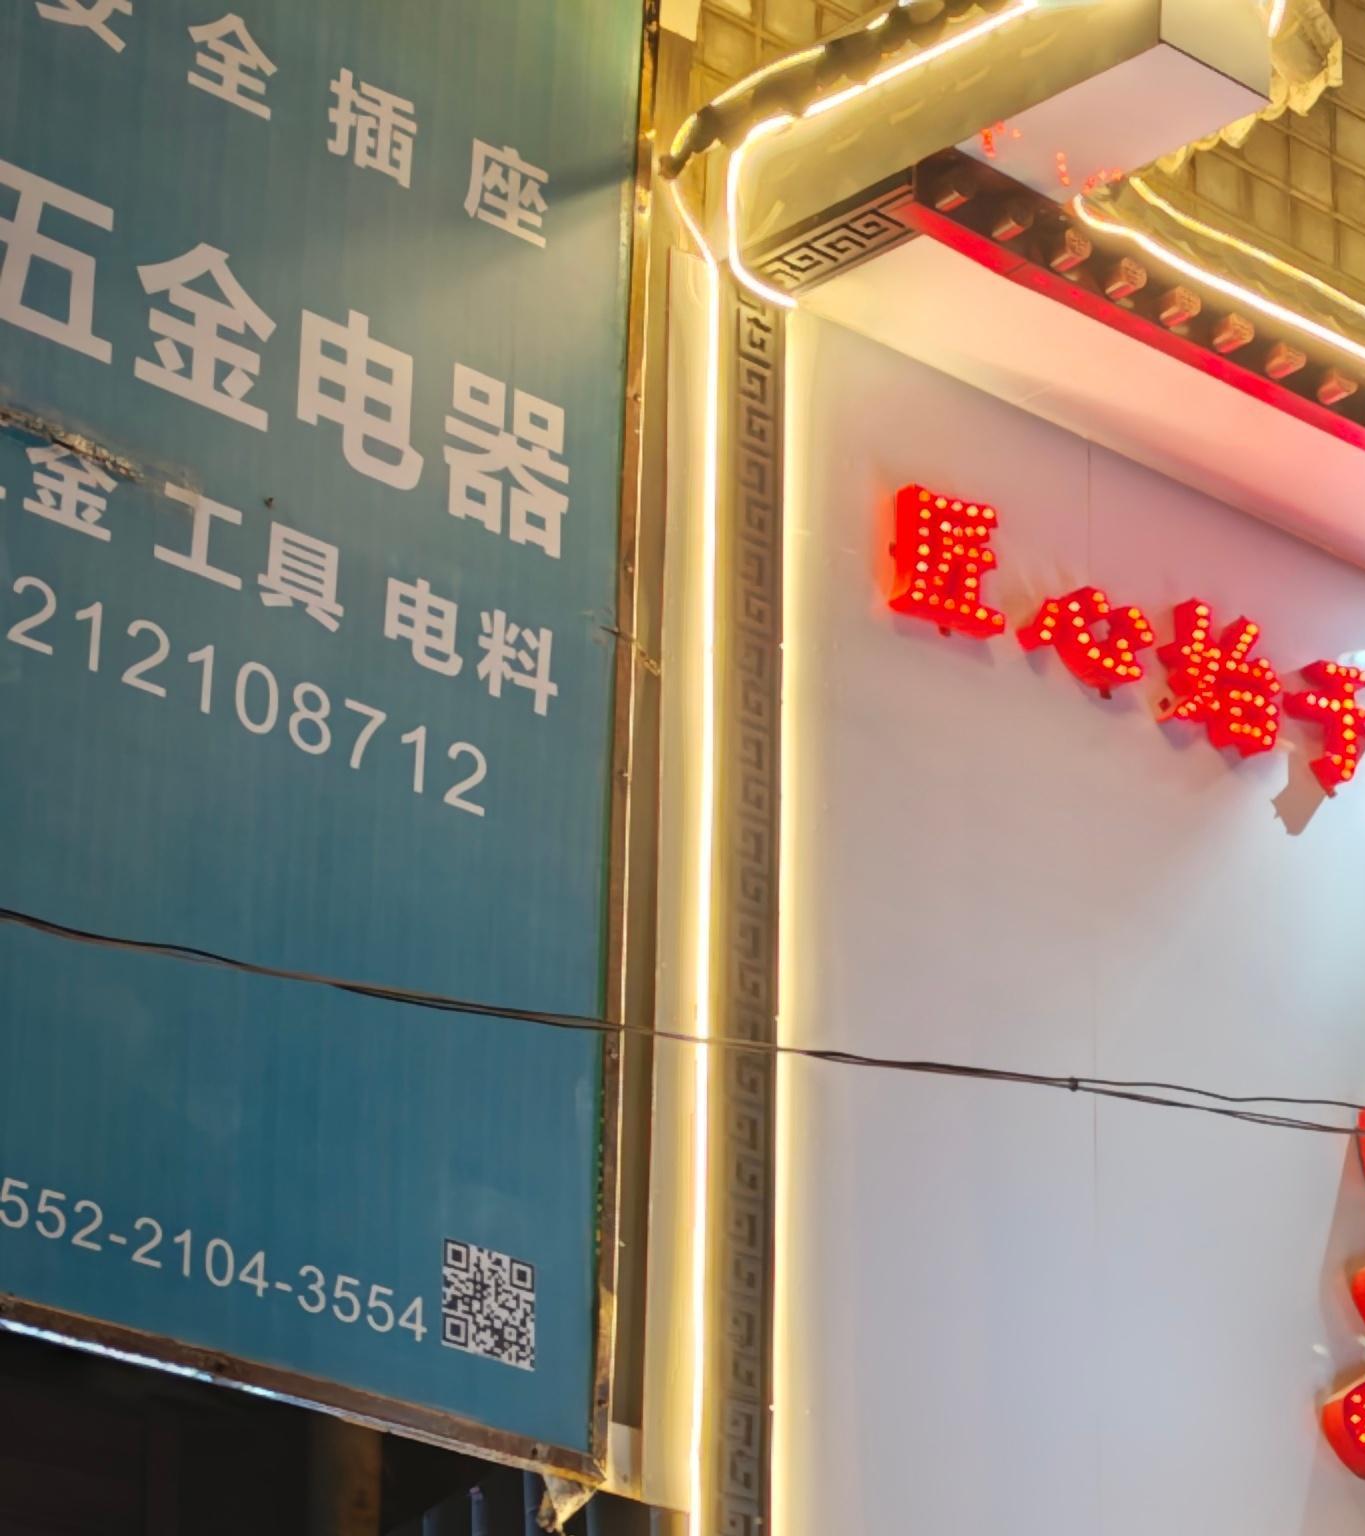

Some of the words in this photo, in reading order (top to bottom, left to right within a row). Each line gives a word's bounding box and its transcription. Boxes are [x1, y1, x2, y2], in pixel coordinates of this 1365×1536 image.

[0, 159, 569, 558] 五金电器
[0, 443, 118, 542] 金
[154, 482, 344, 632] 工具
[384, 577, 558, 717] 电料
[6, 576, 488, 817] 212108712
[0, 1176, 428, 1342] 552-2104-3554
